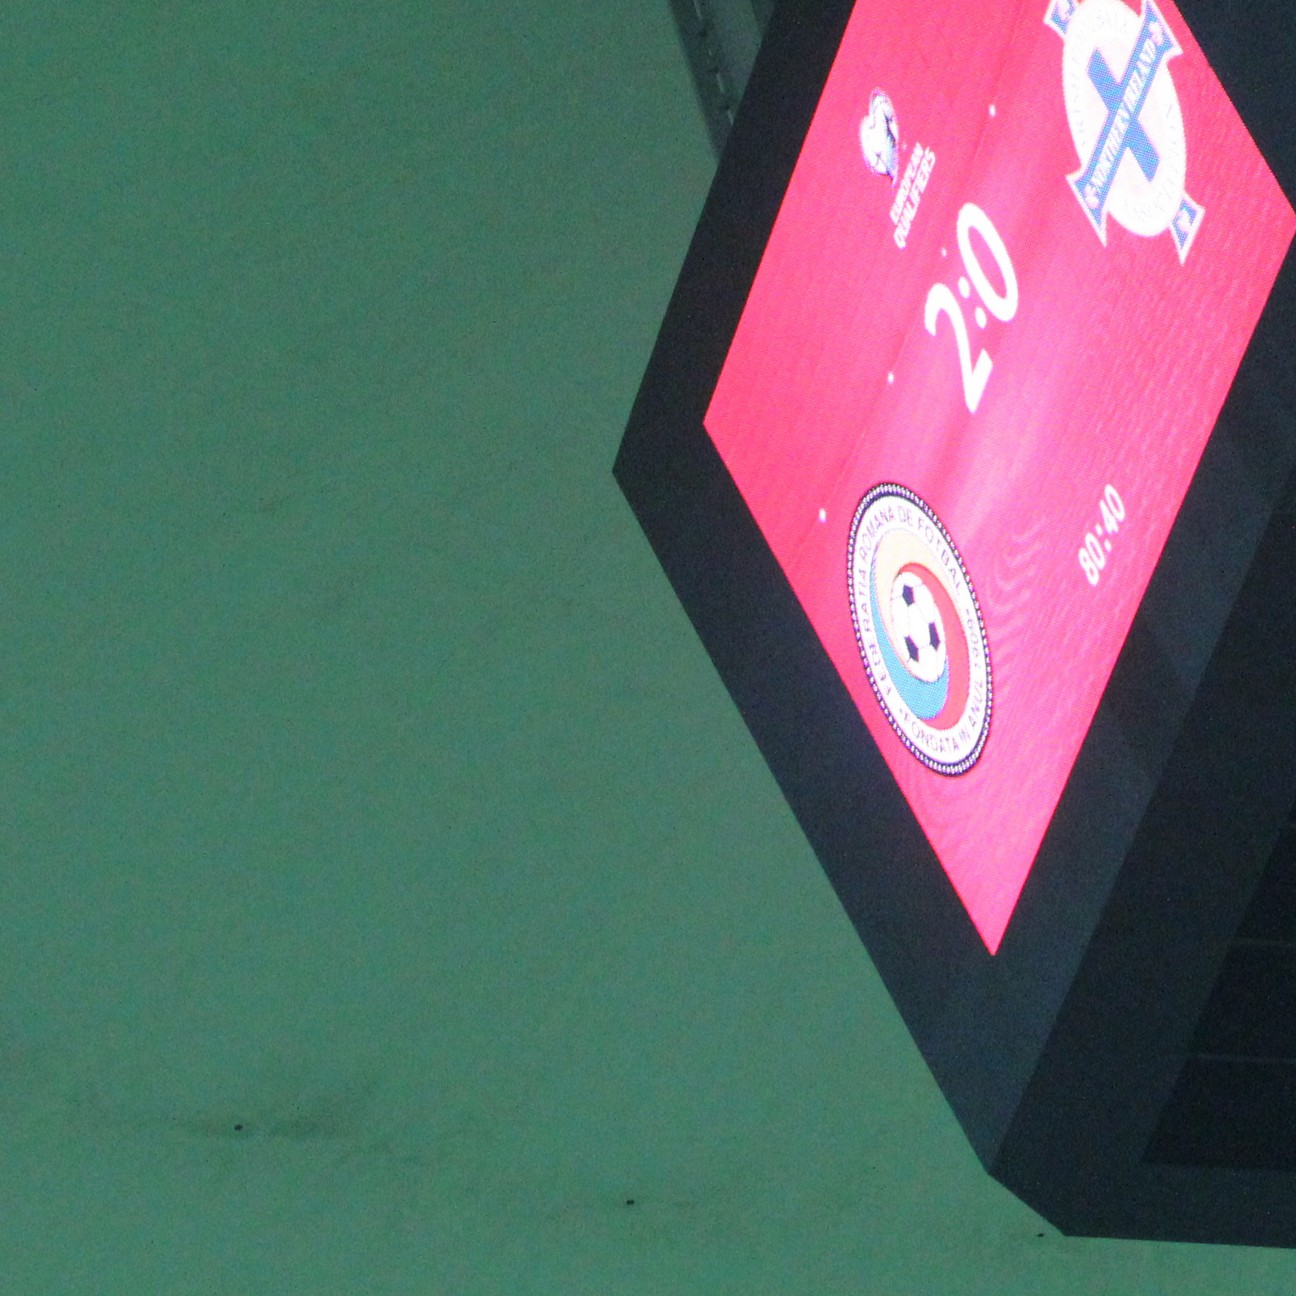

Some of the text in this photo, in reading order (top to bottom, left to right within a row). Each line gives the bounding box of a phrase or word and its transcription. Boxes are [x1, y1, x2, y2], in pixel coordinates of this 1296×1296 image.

[893, 146, 937, 250] QUALIFIERS
[923, 201, 1019, 415] 2:0
[1077, 483, 1126, 587] 80:40
